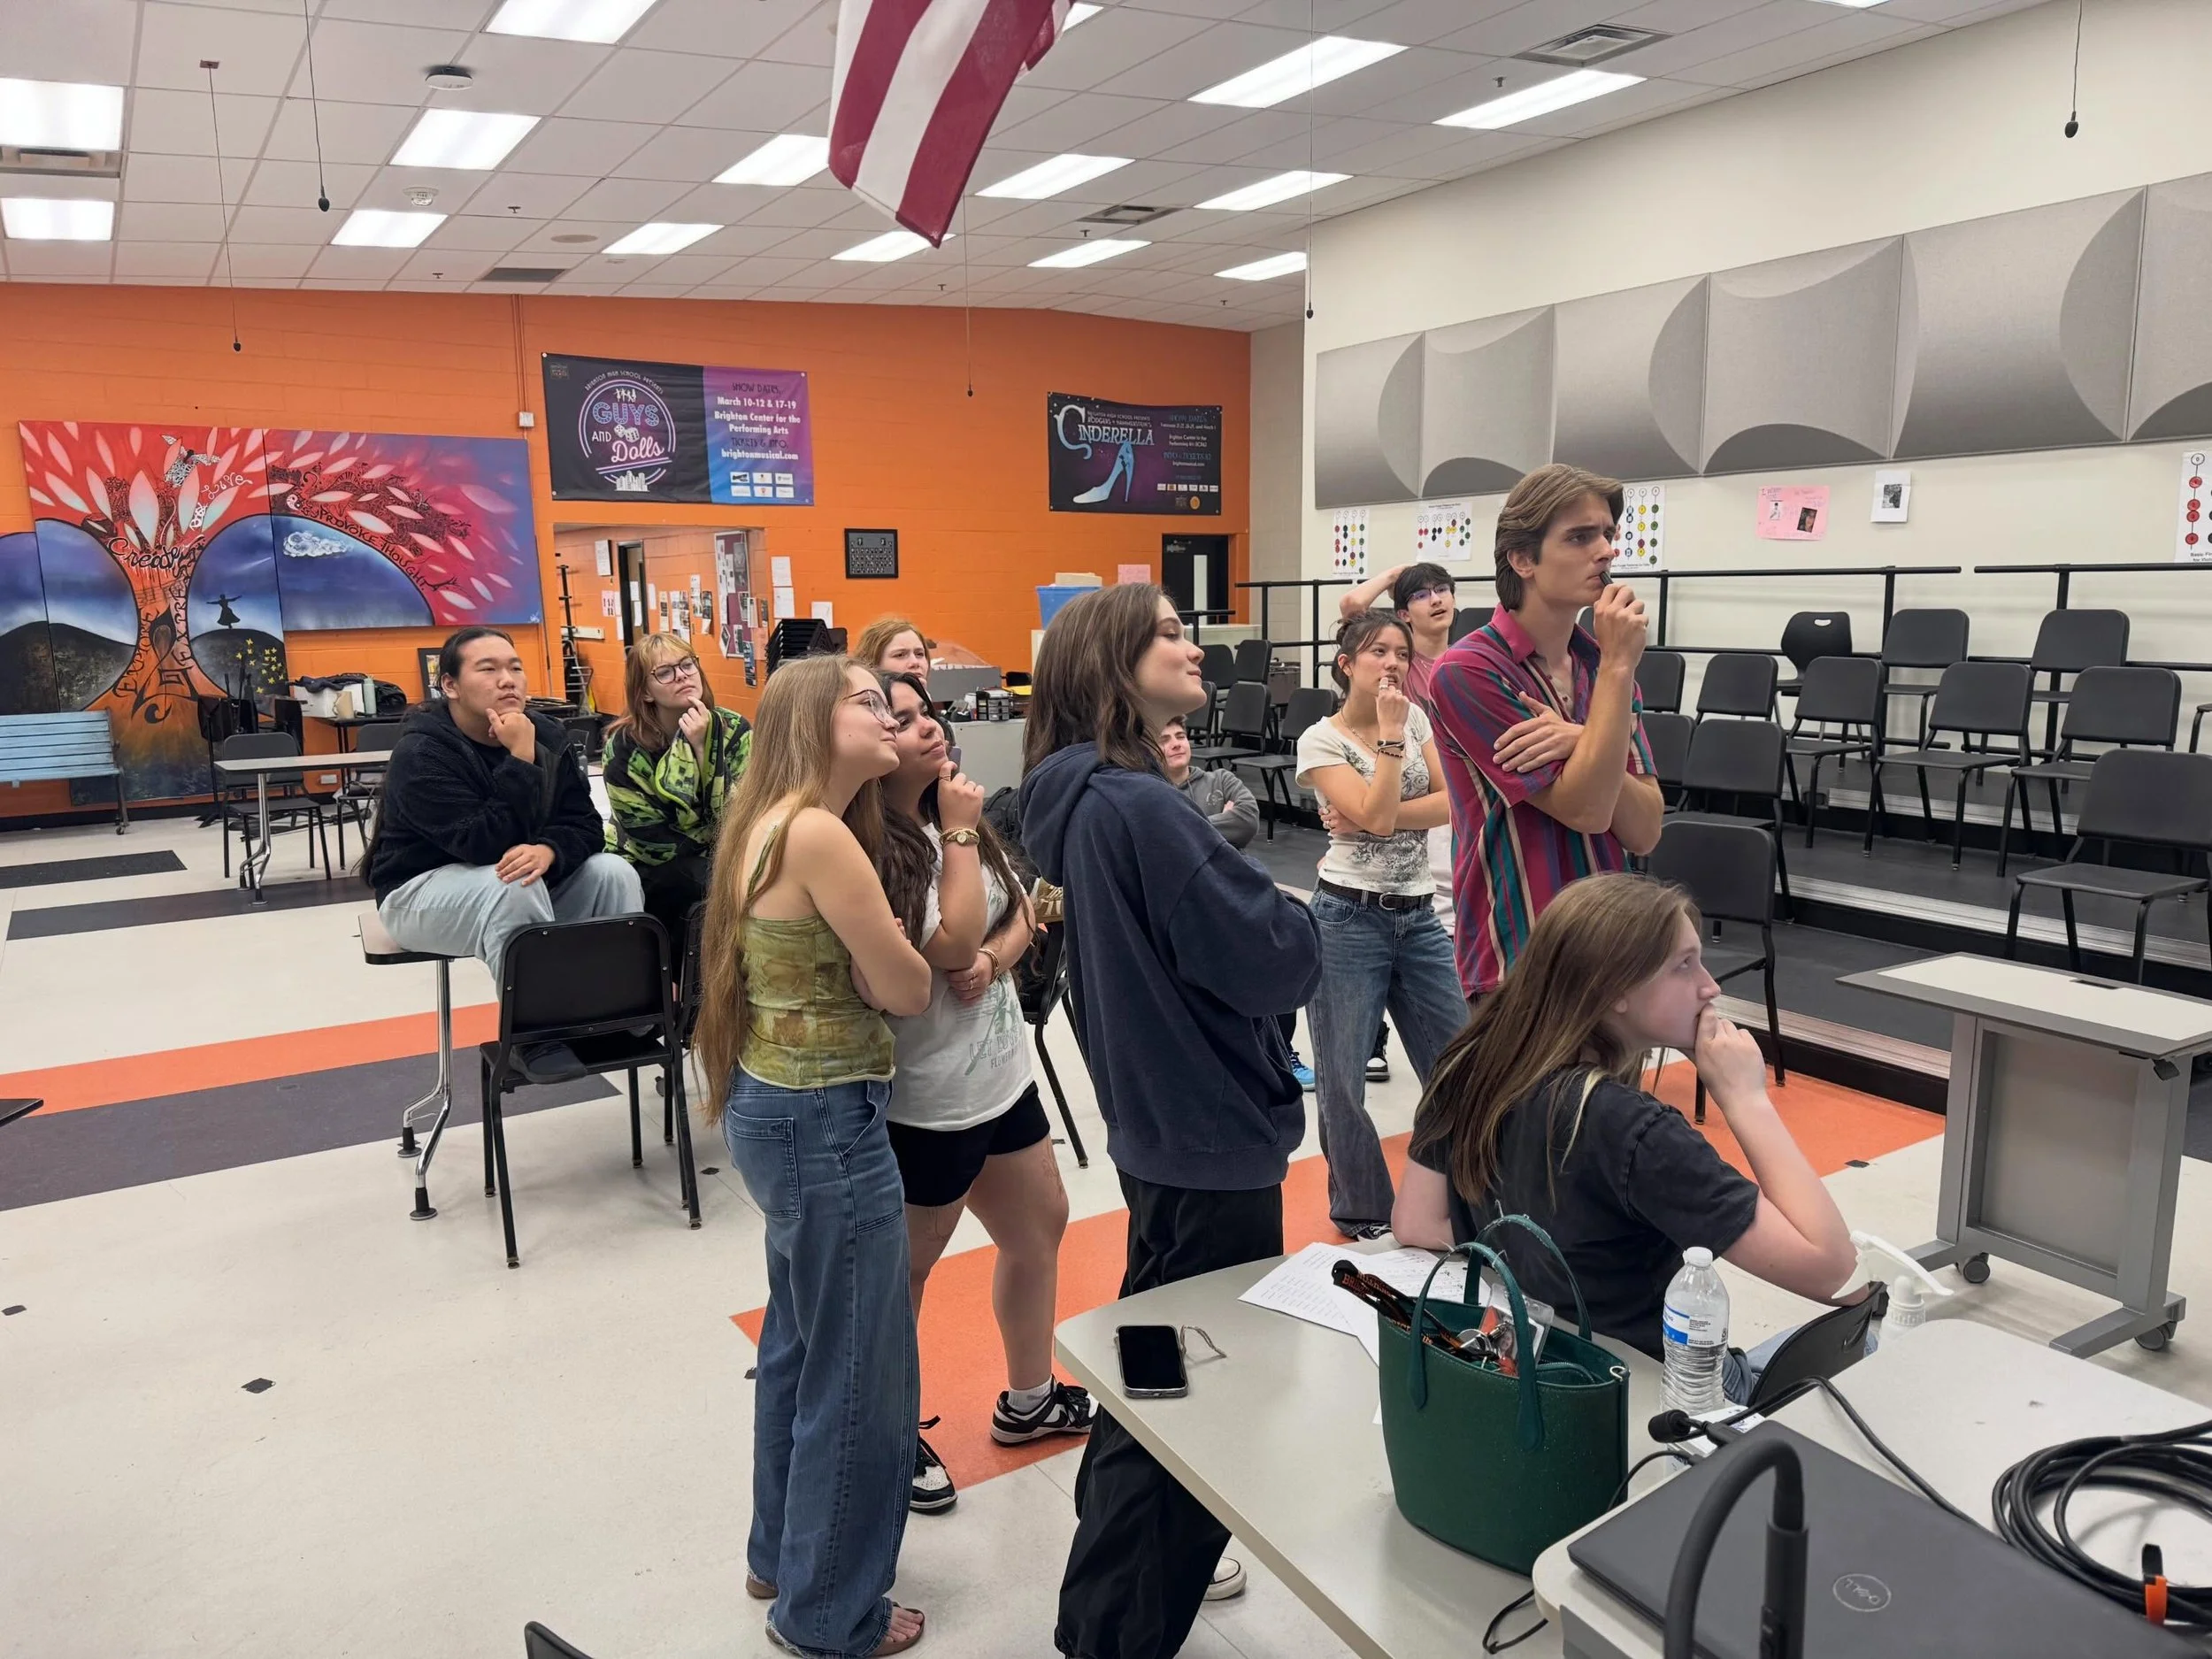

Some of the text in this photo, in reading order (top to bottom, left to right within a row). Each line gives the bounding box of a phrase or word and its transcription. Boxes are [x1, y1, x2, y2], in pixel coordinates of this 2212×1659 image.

[620, 371, 641, 380] SCHOOL
[733, 382, 755, 392] SHOW
[718, 396, 796, 409] March 10-12 & 17-19
[592, 402, 660, 426] GUYS
[714, 411, 801, 424] Brighton Center for the
[729, 424, 789, 435] Performing Arts
[1053, 404, 1155, 460] CINDERELLA
[592, 431, 611, 442] AND
[611, 436, 664, 463] Dolls
[721, 449, 799, 460] brightonmusical.com
[319, 503, 379, 546] PROVOKE
